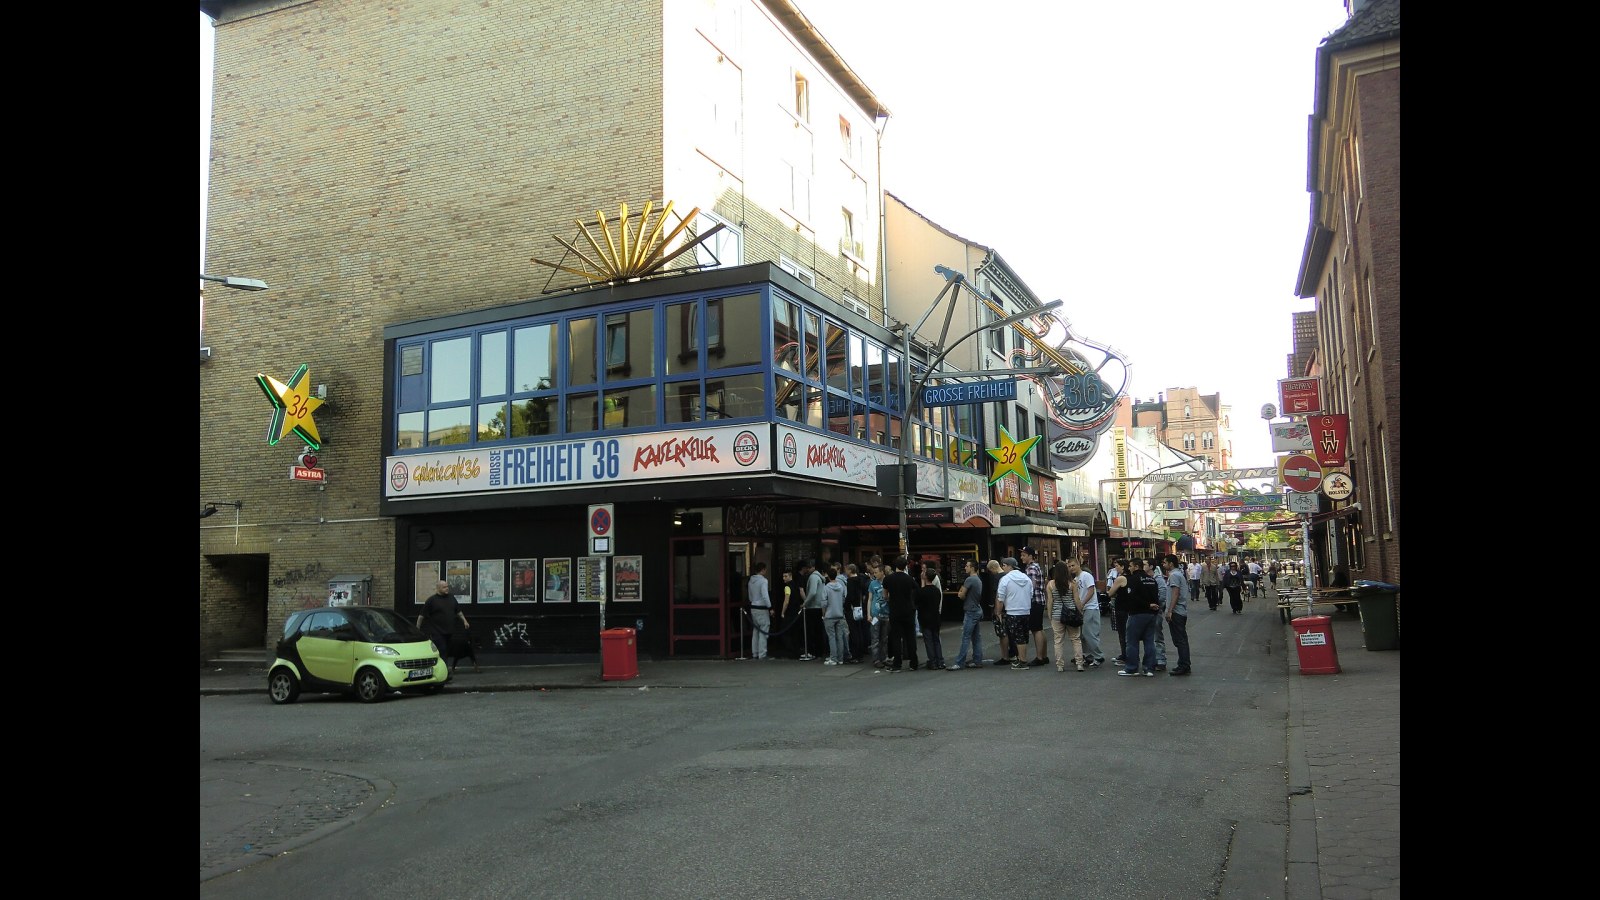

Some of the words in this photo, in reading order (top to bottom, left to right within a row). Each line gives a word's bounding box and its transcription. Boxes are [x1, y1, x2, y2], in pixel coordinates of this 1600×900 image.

[925, 386, 964, 405] GROSSE
[968, 381, 1014, 400] FREIHEIT
[1064, 372, 1101, 408] 36
[287, 394, 309, 419] 36
[633, 435, 720, 472] KAISERKELLER
[1000, 445, 1017, 465] 36
[1055, 440, 1091, 454] Colibri
[296, 470, 322, 479] ASTRA
[489, 450, 501, 486] GROSSE
[503, 442, 586, 486] FREIHEIT
[592, 439, 620, 480] 36
[1118, 478, 1127, 500] Hote
